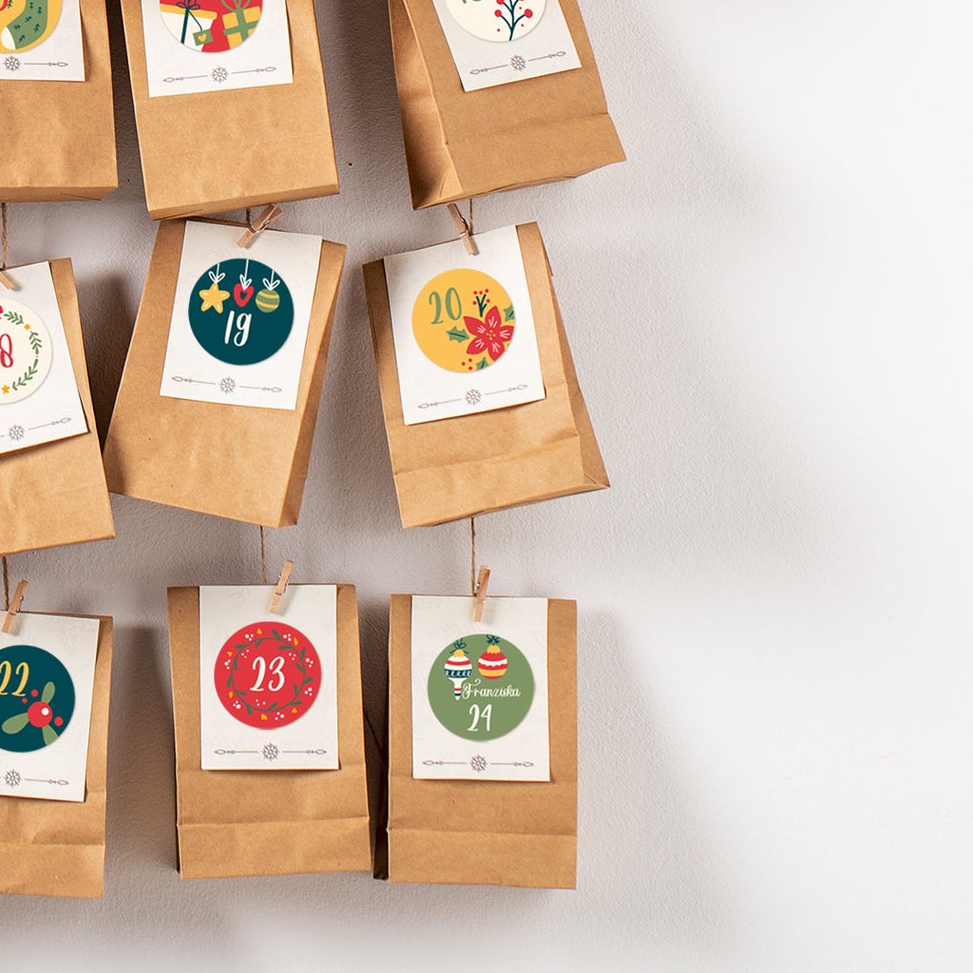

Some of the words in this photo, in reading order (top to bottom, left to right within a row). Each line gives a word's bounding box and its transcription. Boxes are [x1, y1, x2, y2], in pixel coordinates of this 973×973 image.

[428, 287, 462, 325] 20
[224, 310, 252, 347] 19
[249, 656, 286, 692] 23
[461, 679, 521, 699] Franziska
[467, 704, 493, 732] 24
